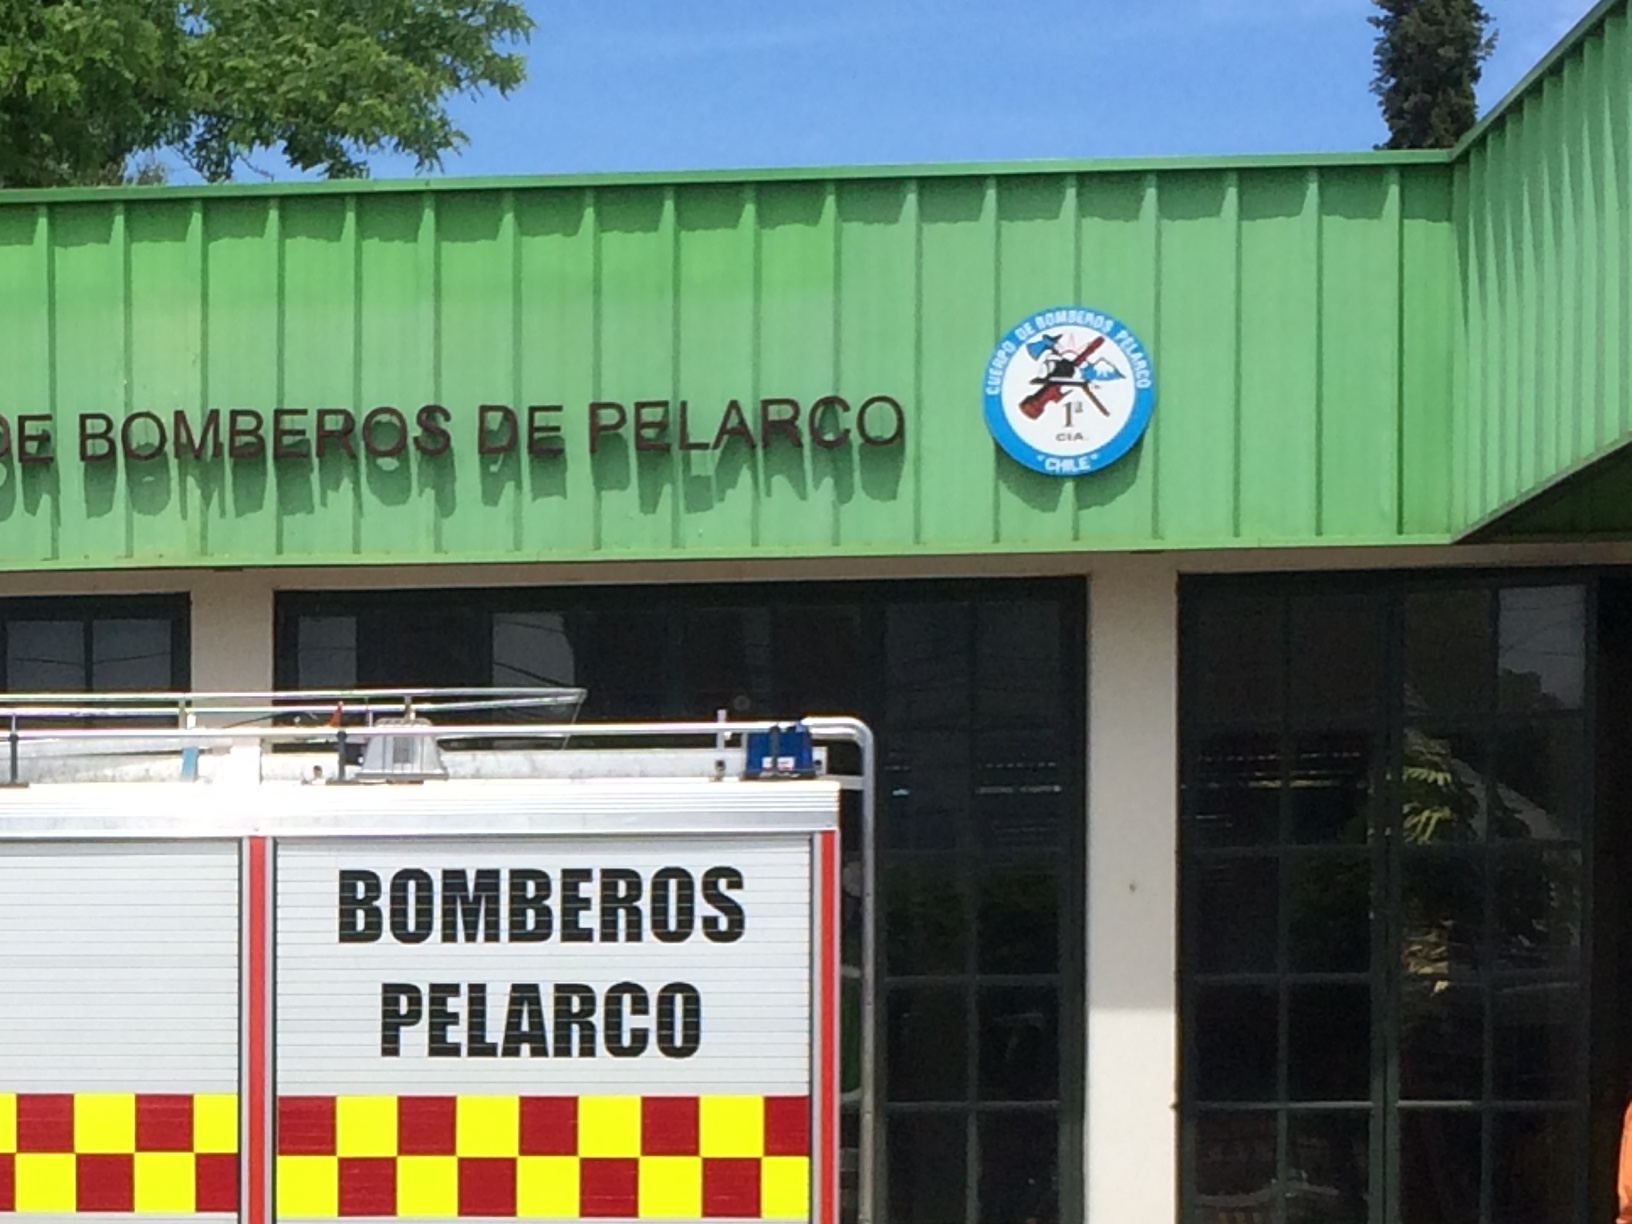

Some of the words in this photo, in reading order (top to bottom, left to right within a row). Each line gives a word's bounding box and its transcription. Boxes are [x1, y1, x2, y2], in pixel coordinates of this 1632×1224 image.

[986, 340, 1016, 395] CUERPO
[1015, 322, 1037, 341] DE
[1035, 310, 1114, 331] BOMBEROS
[1114, 330, 1152, 389] PELARCO
[79, 405, 451, 463] BOMBEROS
[478, 405, 565, 456] DE
[589, 396, 904, 452] PELARCO
[338, 866, 745, 944] BOMBEROS
[381, 981, 701, 1059] PELARCO
